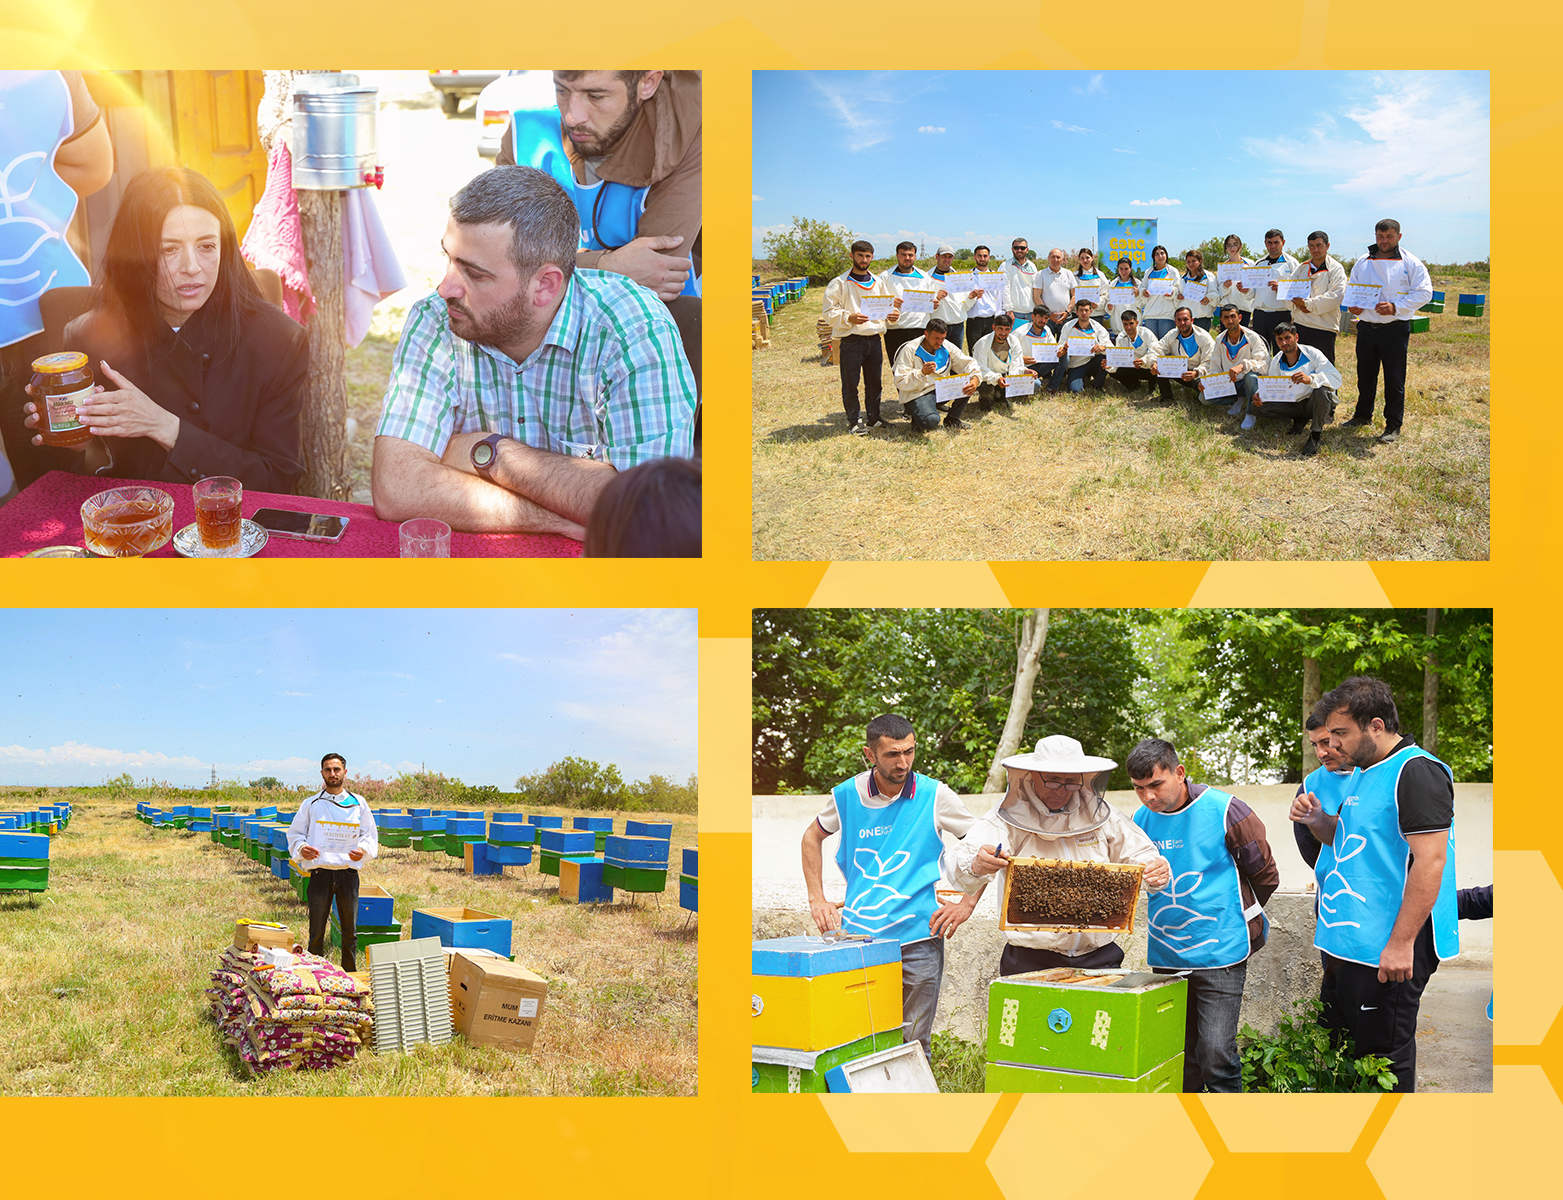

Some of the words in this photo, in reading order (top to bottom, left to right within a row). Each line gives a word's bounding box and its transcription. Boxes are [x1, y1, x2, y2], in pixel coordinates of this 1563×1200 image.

[1109, 237, 1145, 250] Gənc
[859, 826, 881, 839] ONE
[501, 1003, 518, 1011] MUM
[483, 1013, 507, 1023] ERİTME
[508, 1018, 532, 1027] KAZANI
